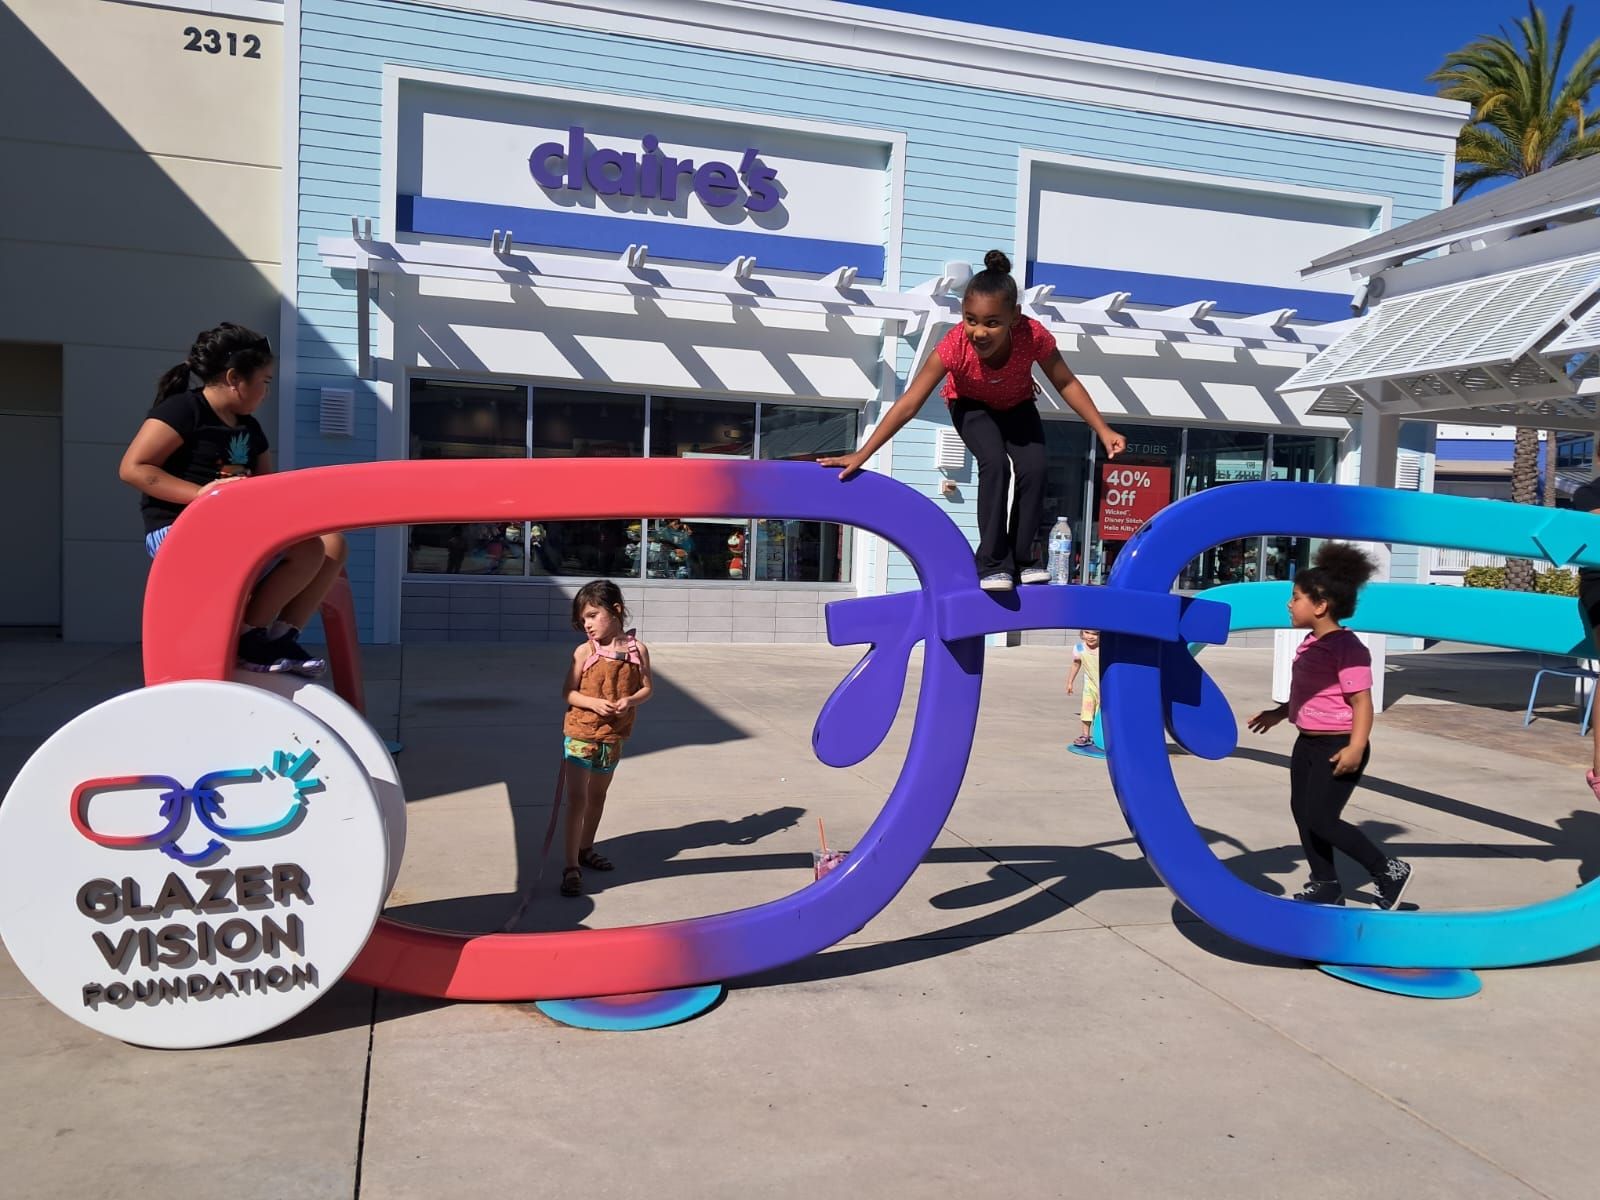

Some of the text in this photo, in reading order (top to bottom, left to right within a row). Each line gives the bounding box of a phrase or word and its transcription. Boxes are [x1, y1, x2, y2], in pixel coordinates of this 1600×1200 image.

[183, 26, 261, 59] 2312
[529, 126, 780, 212] claire's
[1143, 444, 1168, 454] DIBS
[1106, 470, 1151, 487] 40%
[1106, 489, 1136, 506] Off
[76, 863, 312, 920] GLAZER
[92, 913, 303, 971] VISION
[82, 961, 316, 1008] FOUNDATION
